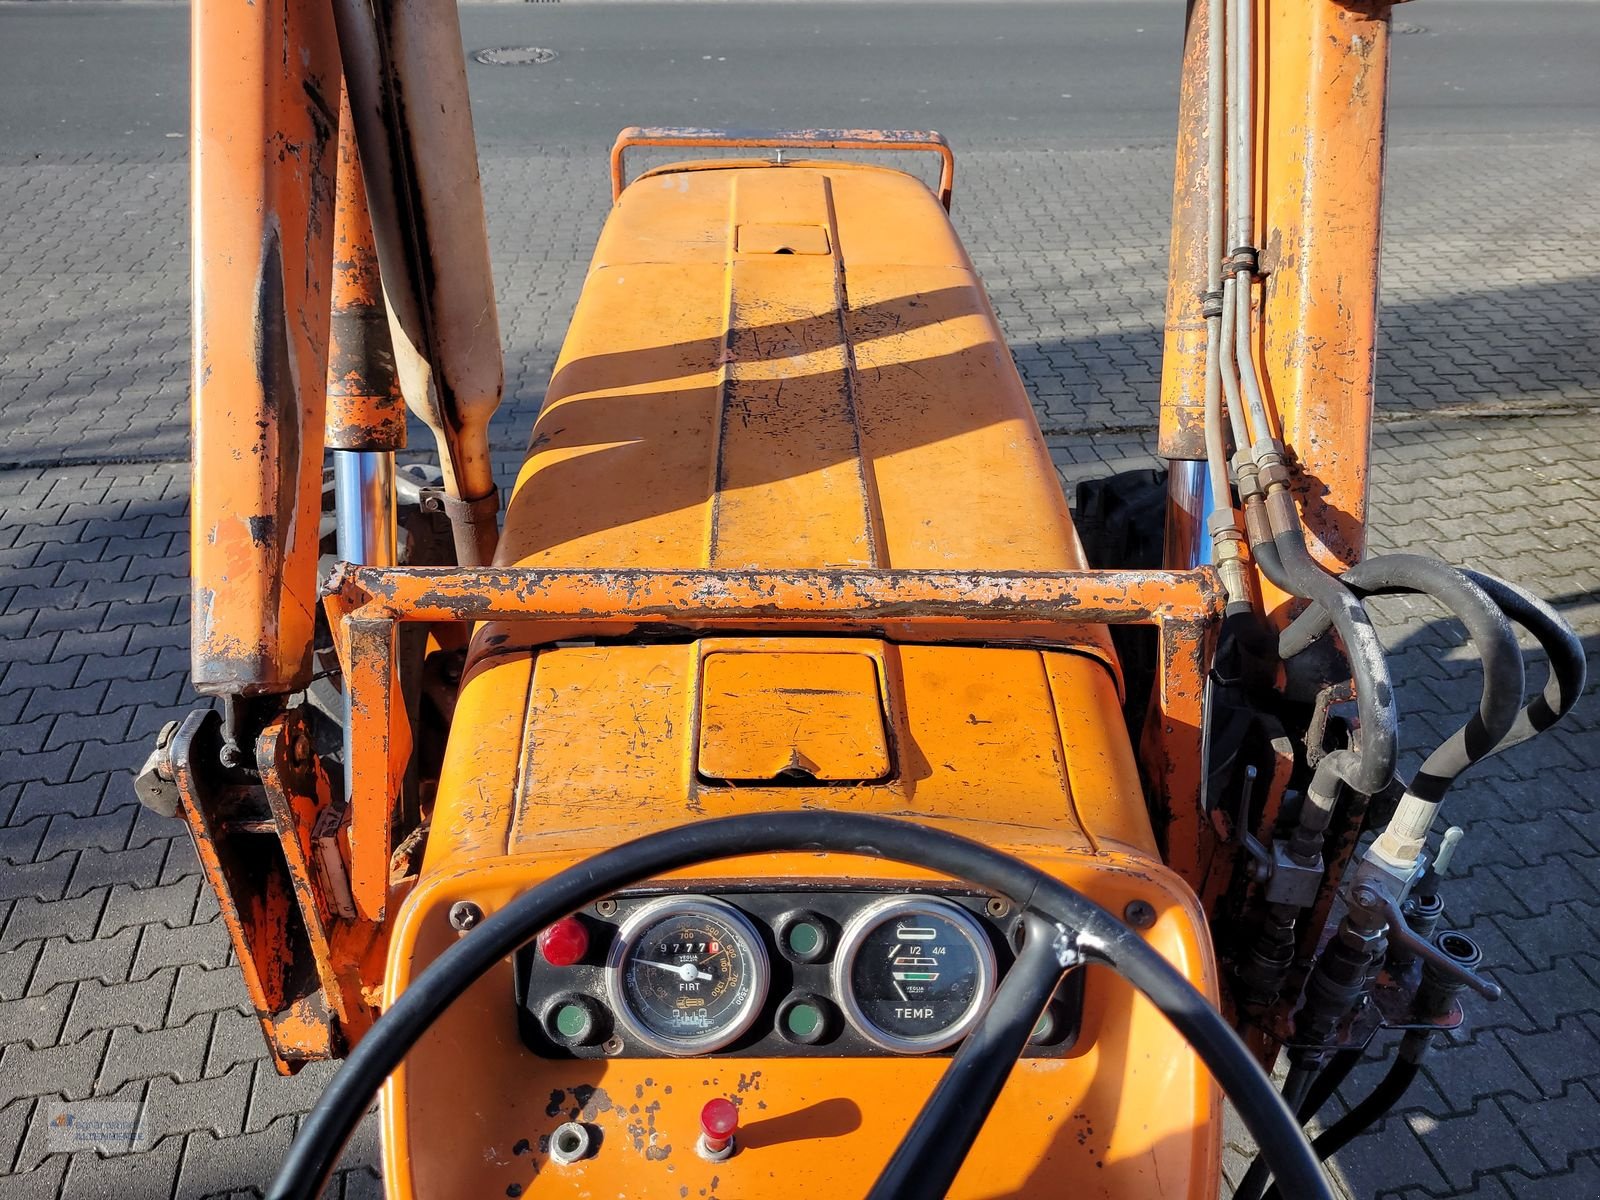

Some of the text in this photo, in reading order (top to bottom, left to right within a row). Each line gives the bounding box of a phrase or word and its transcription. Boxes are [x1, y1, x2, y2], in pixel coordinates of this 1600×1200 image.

[705, 925, 719, 936] 500
[726, 945, 737, 959] 600
[679, 983, 700, 991] FIAT
[730, 974, 739, 987] 700
[711, 982, 725, 997] 1300
[735, 986, 748, 1005] 2500
[895, 1009, 934, 1018] TEMP.
